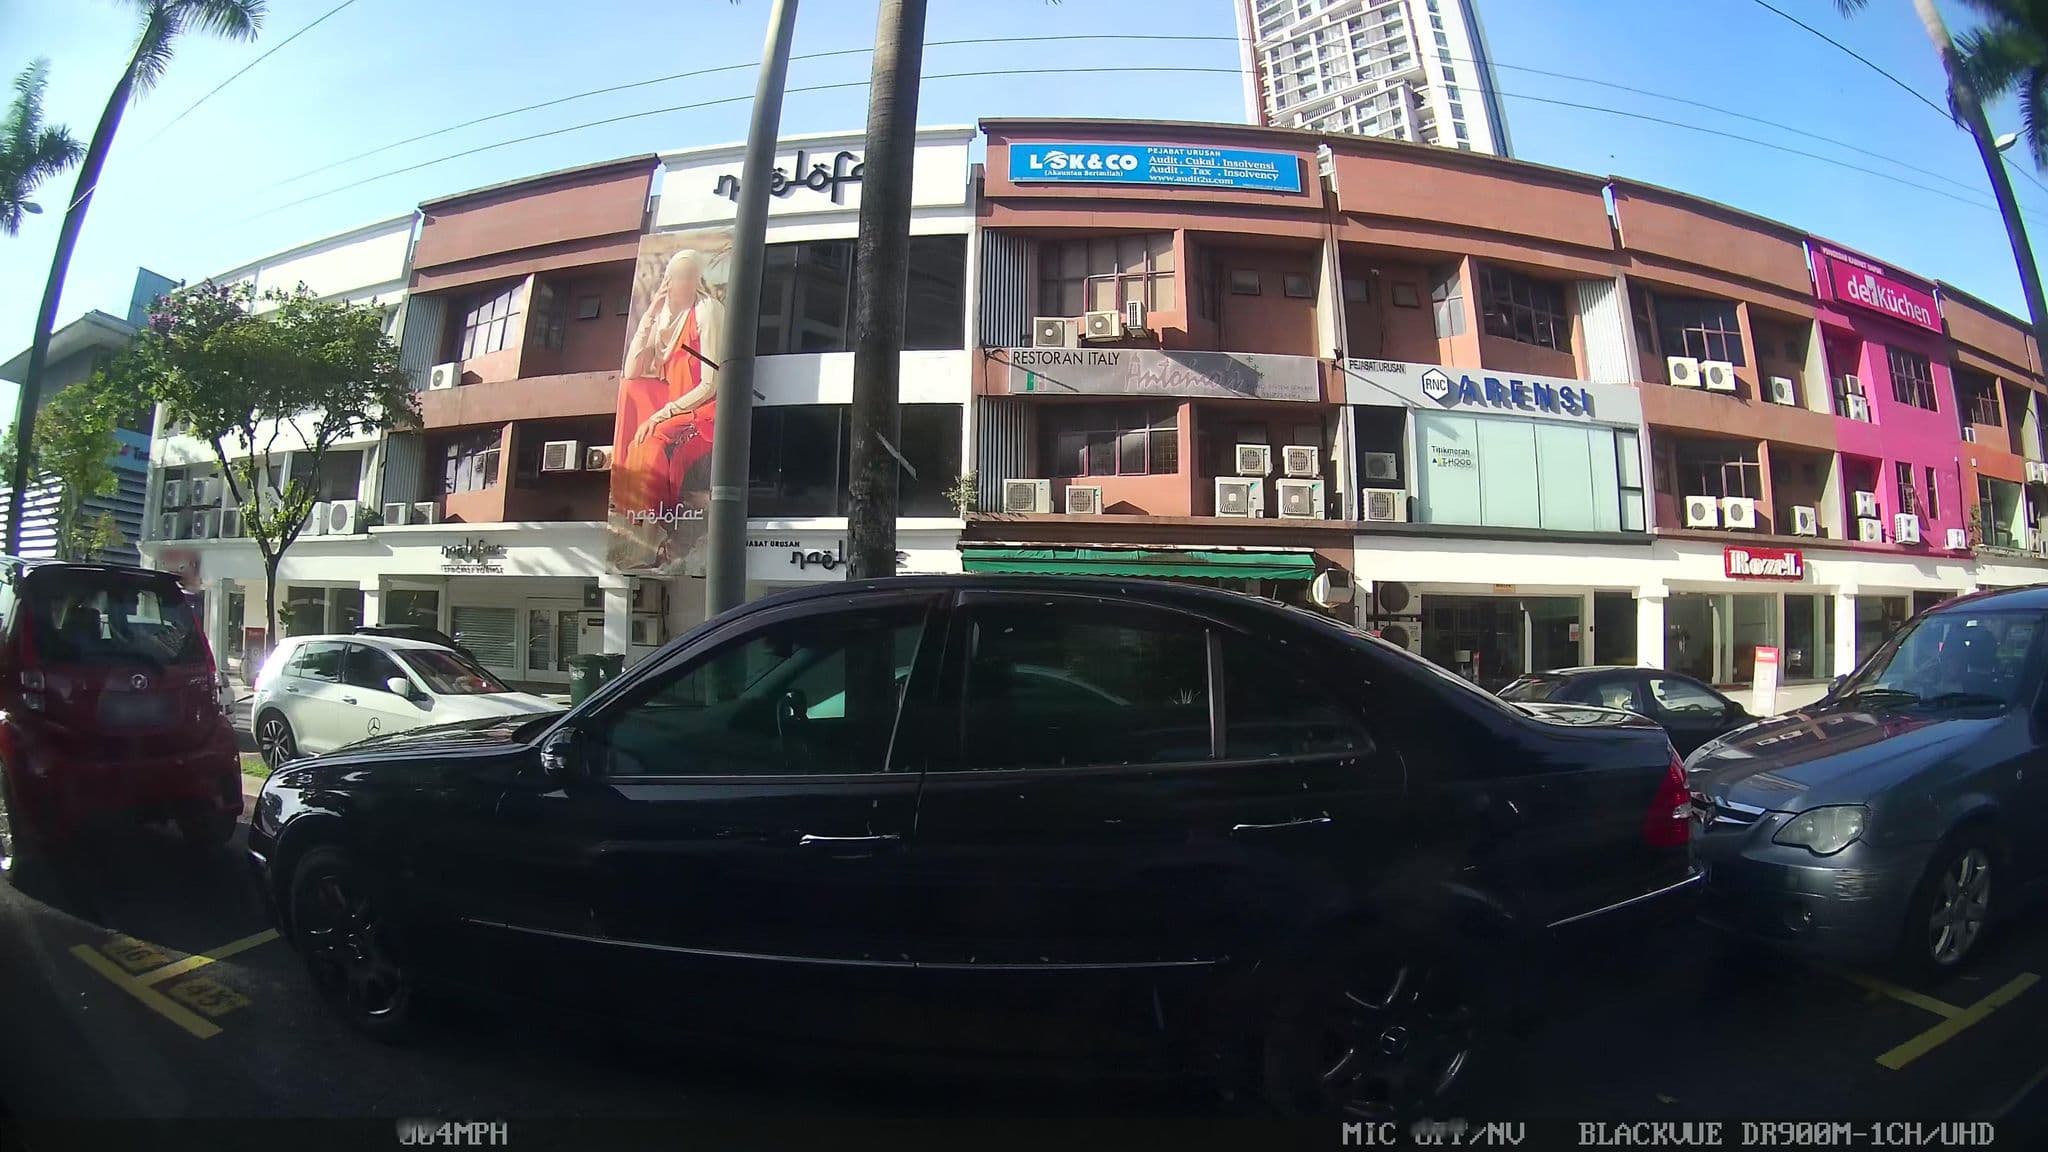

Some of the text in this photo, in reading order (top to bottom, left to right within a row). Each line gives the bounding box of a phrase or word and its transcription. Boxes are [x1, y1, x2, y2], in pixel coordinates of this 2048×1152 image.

[1147, 147, 1221, 157] PEJABAT URUSAN
[1149, 156, 1275, 170] Audit Cukai Insolvensi
[1149, 166, 1279, 181] Audit Tax Insolvency
[1149, 175, 1234, 185] www.audit2u.com
[1013, 351, 1120, 365] RESTORAN ITALY
[1349, 360, 1376, 371] PEJABAT
[1425, 378, 1447, 391] RNC
[1458, 375, 1589, 413] ARENSI
[770, 540, 800, 548] URUSAN
